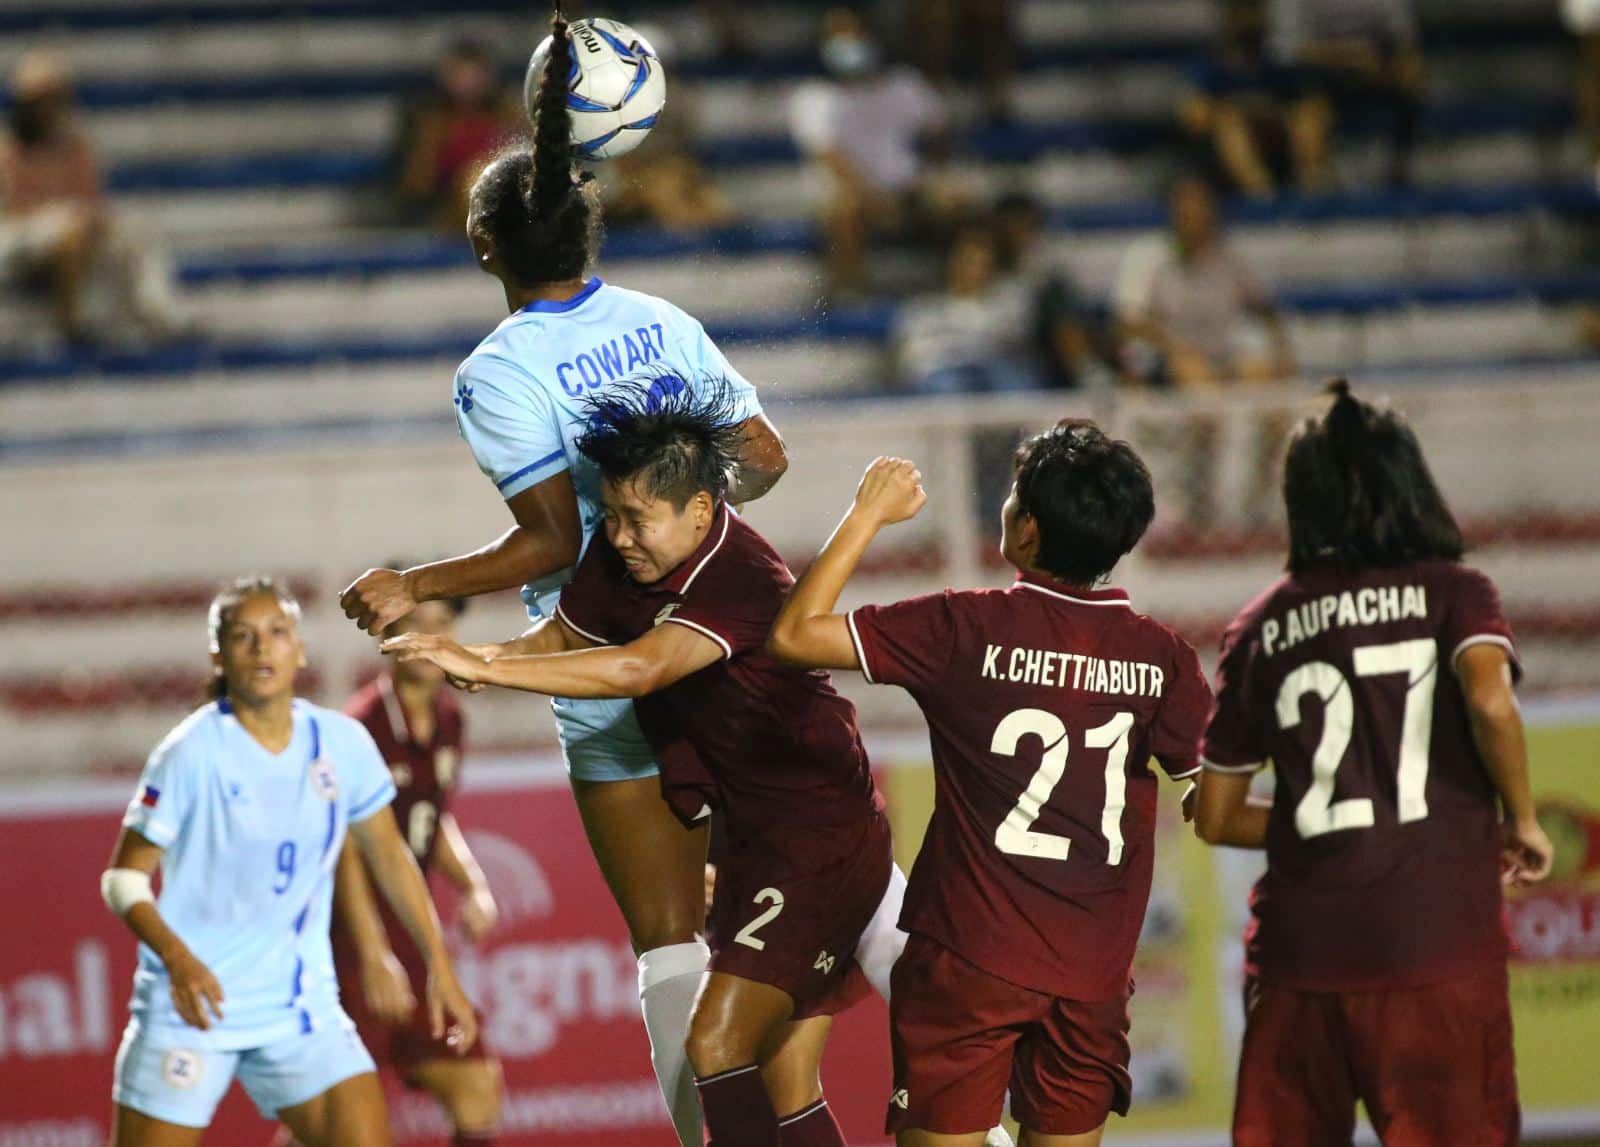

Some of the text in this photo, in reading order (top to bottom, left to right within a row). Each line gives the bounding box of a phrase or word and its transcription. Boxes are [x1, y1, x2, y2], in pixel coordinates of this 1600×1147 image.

[556, 322, 665, 397] COWART
[1262, 585, 1428, 656] P.AUPACHAI
[981, 644, 1164, 698] K.CHETTHABUTR
[1275, 637, 1438, 840] 27
[990, 708, 1135, 866] 21
[272, 840, 296, 895] 9
[734, 887, 784, 951] 2
[0, 937, 112, 1058] al
